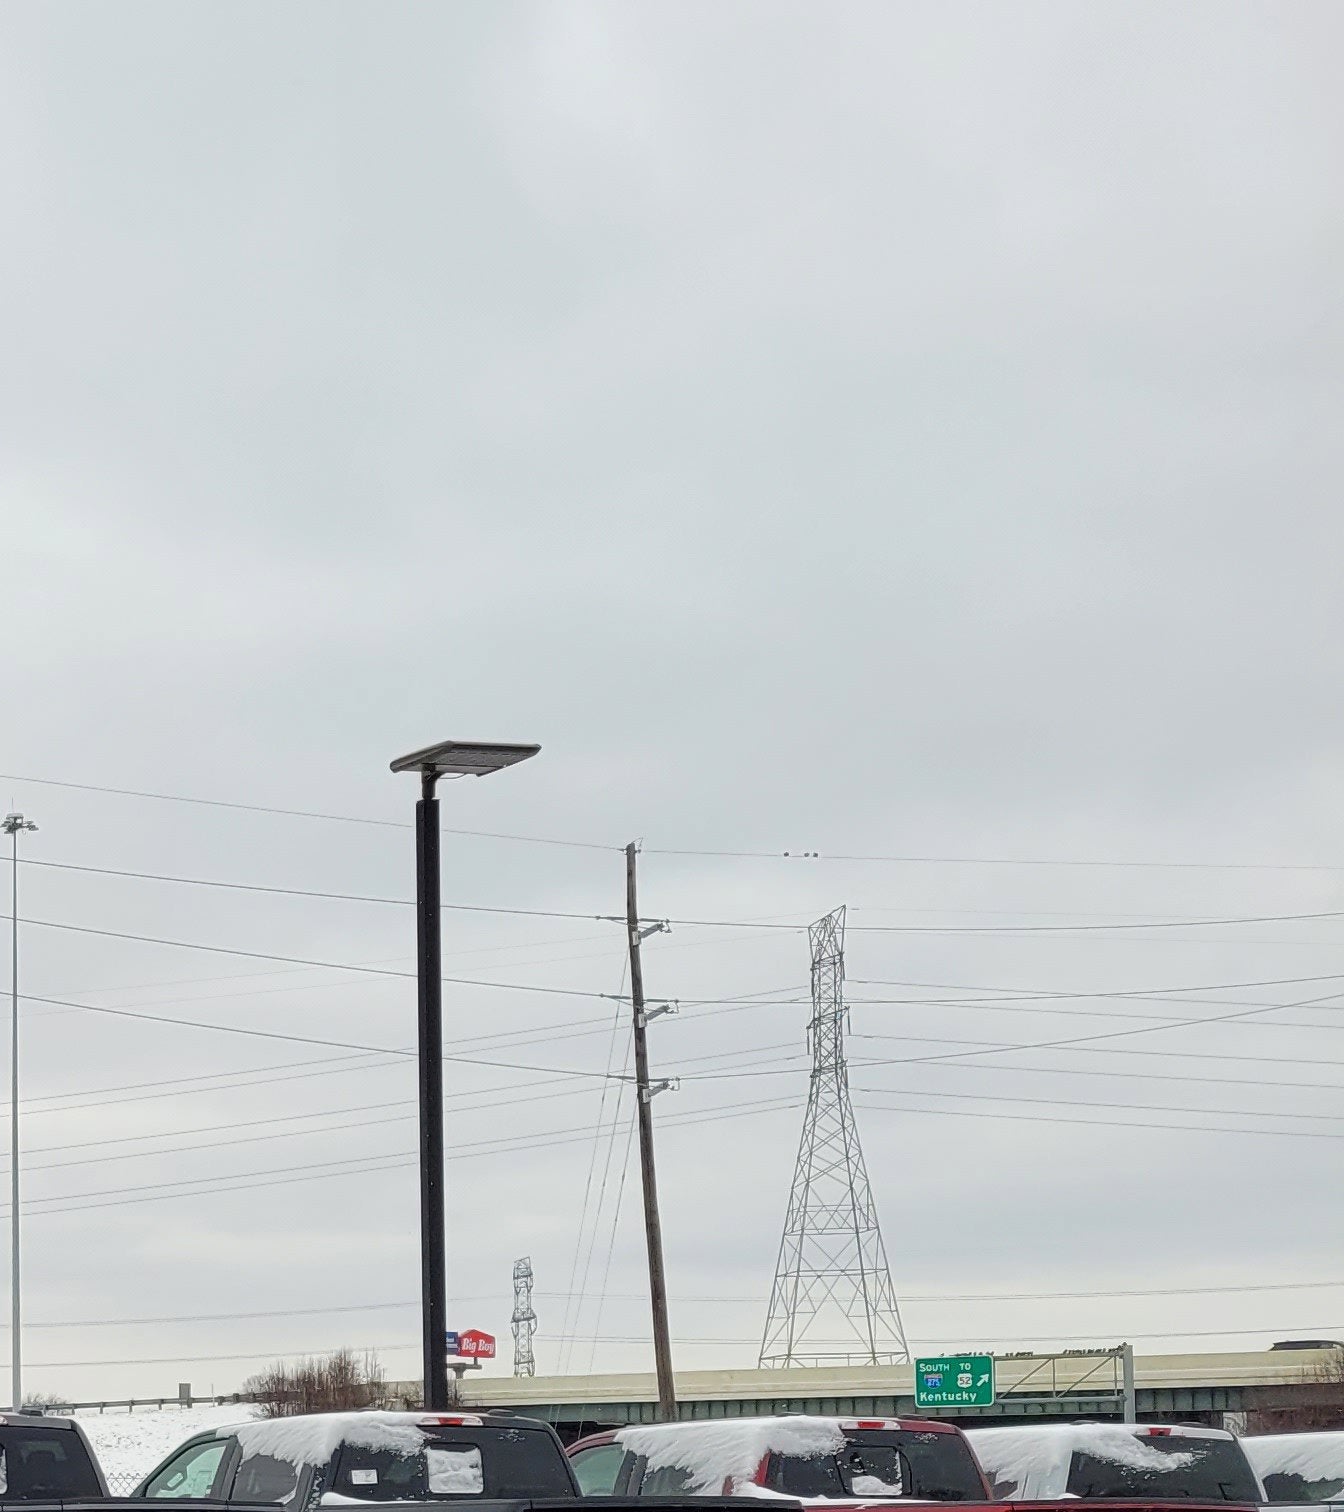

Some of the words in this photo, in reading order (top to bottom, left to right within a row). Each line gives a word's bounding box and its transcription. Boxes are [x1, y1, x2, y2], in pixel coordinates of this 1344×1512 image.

[462, 1336, 477, 1354] Big
[478, 1338, 495, 1355] Boy
[919, 1363, 950, 1372] SOUTH
[959, 1362, 972, 1371] TO
[959, 1376, 971, 1385] 52
[919, 1391, 976, 1402] Kentucky
